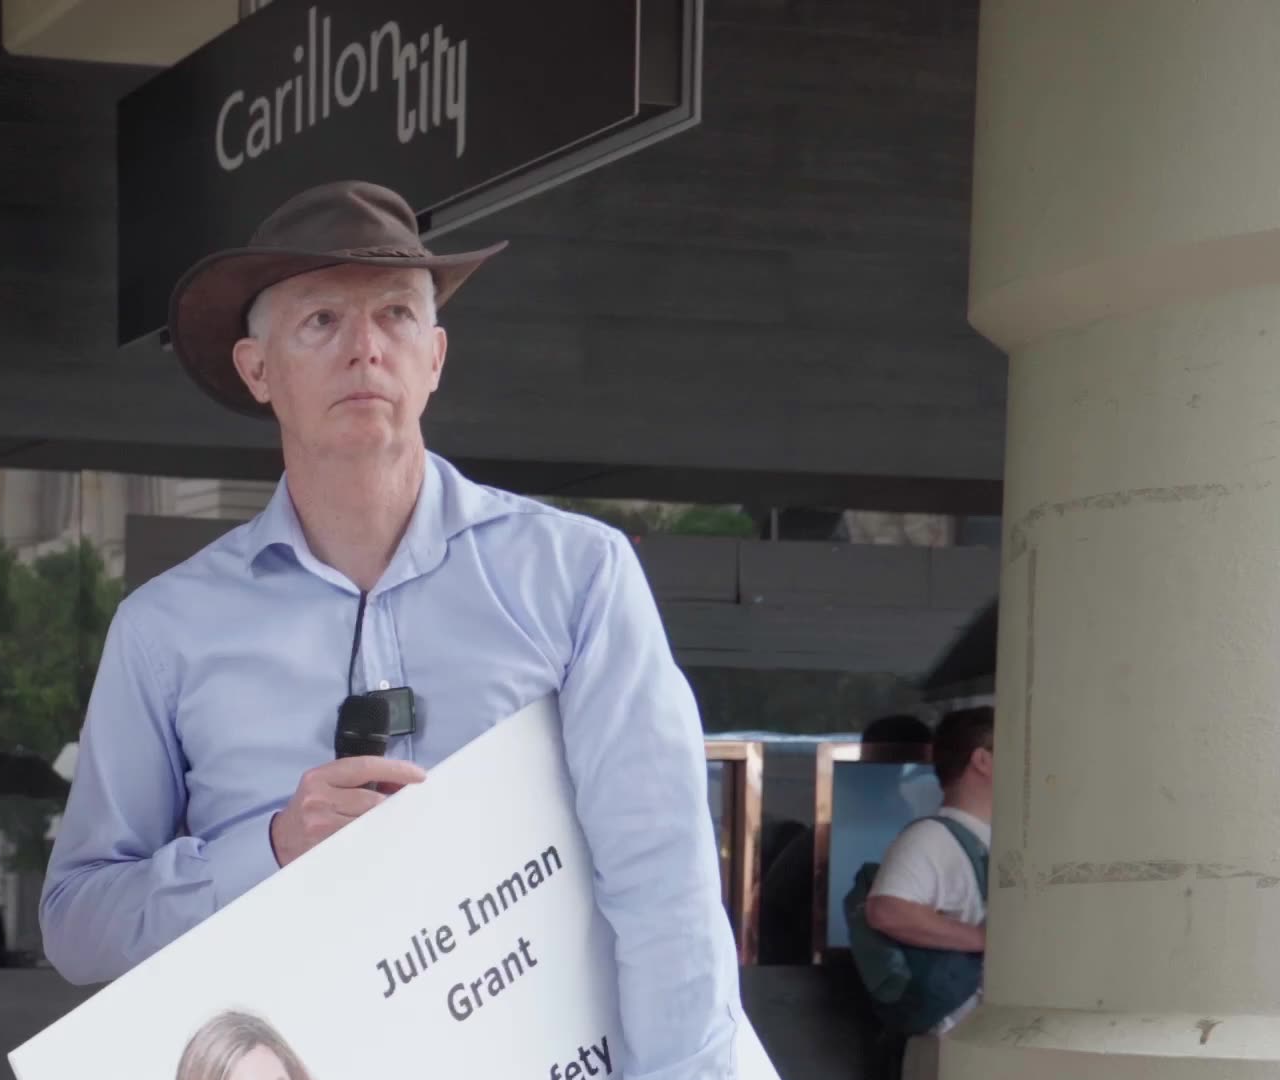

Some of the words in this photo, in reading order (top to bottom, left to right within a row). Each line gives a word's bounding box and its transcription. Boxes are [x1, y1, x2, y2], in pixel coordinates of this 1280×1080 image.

[215, 6, 402, 171] Carillon
[395, 24, 468, 158] city
[377, 926, 456, 999] Julie
[458, 845, 562, 936] Inman
[448, 937, 537, 1021] Grant
